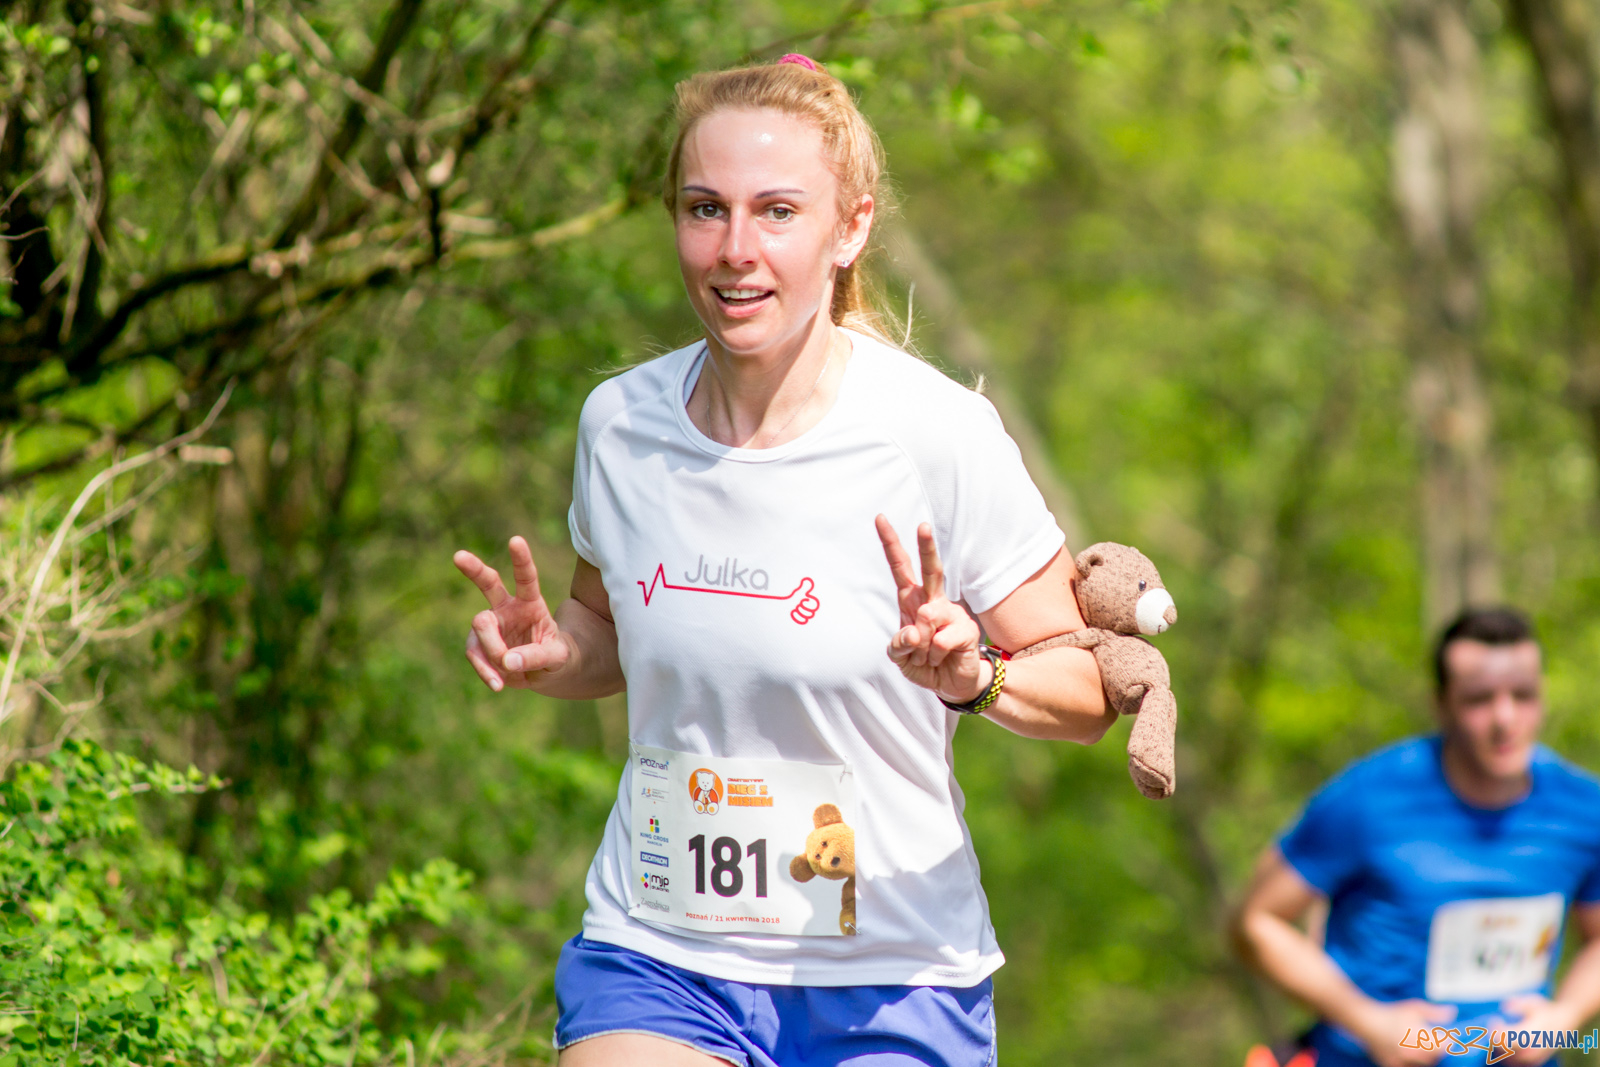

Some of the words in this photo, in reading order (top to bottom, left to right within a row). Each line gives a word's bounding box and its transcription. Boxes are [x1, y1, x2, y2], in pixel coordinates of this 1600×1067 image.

[684, 554, 769, 591] Julka
[727, 784, 756, 795] BIEG
[727, 796, 774, 807] MISIEM
[653, 835, 669, 843] CROSS
[688, 834, 767, 898] 181
[651, 874, 669, 887] mjp
